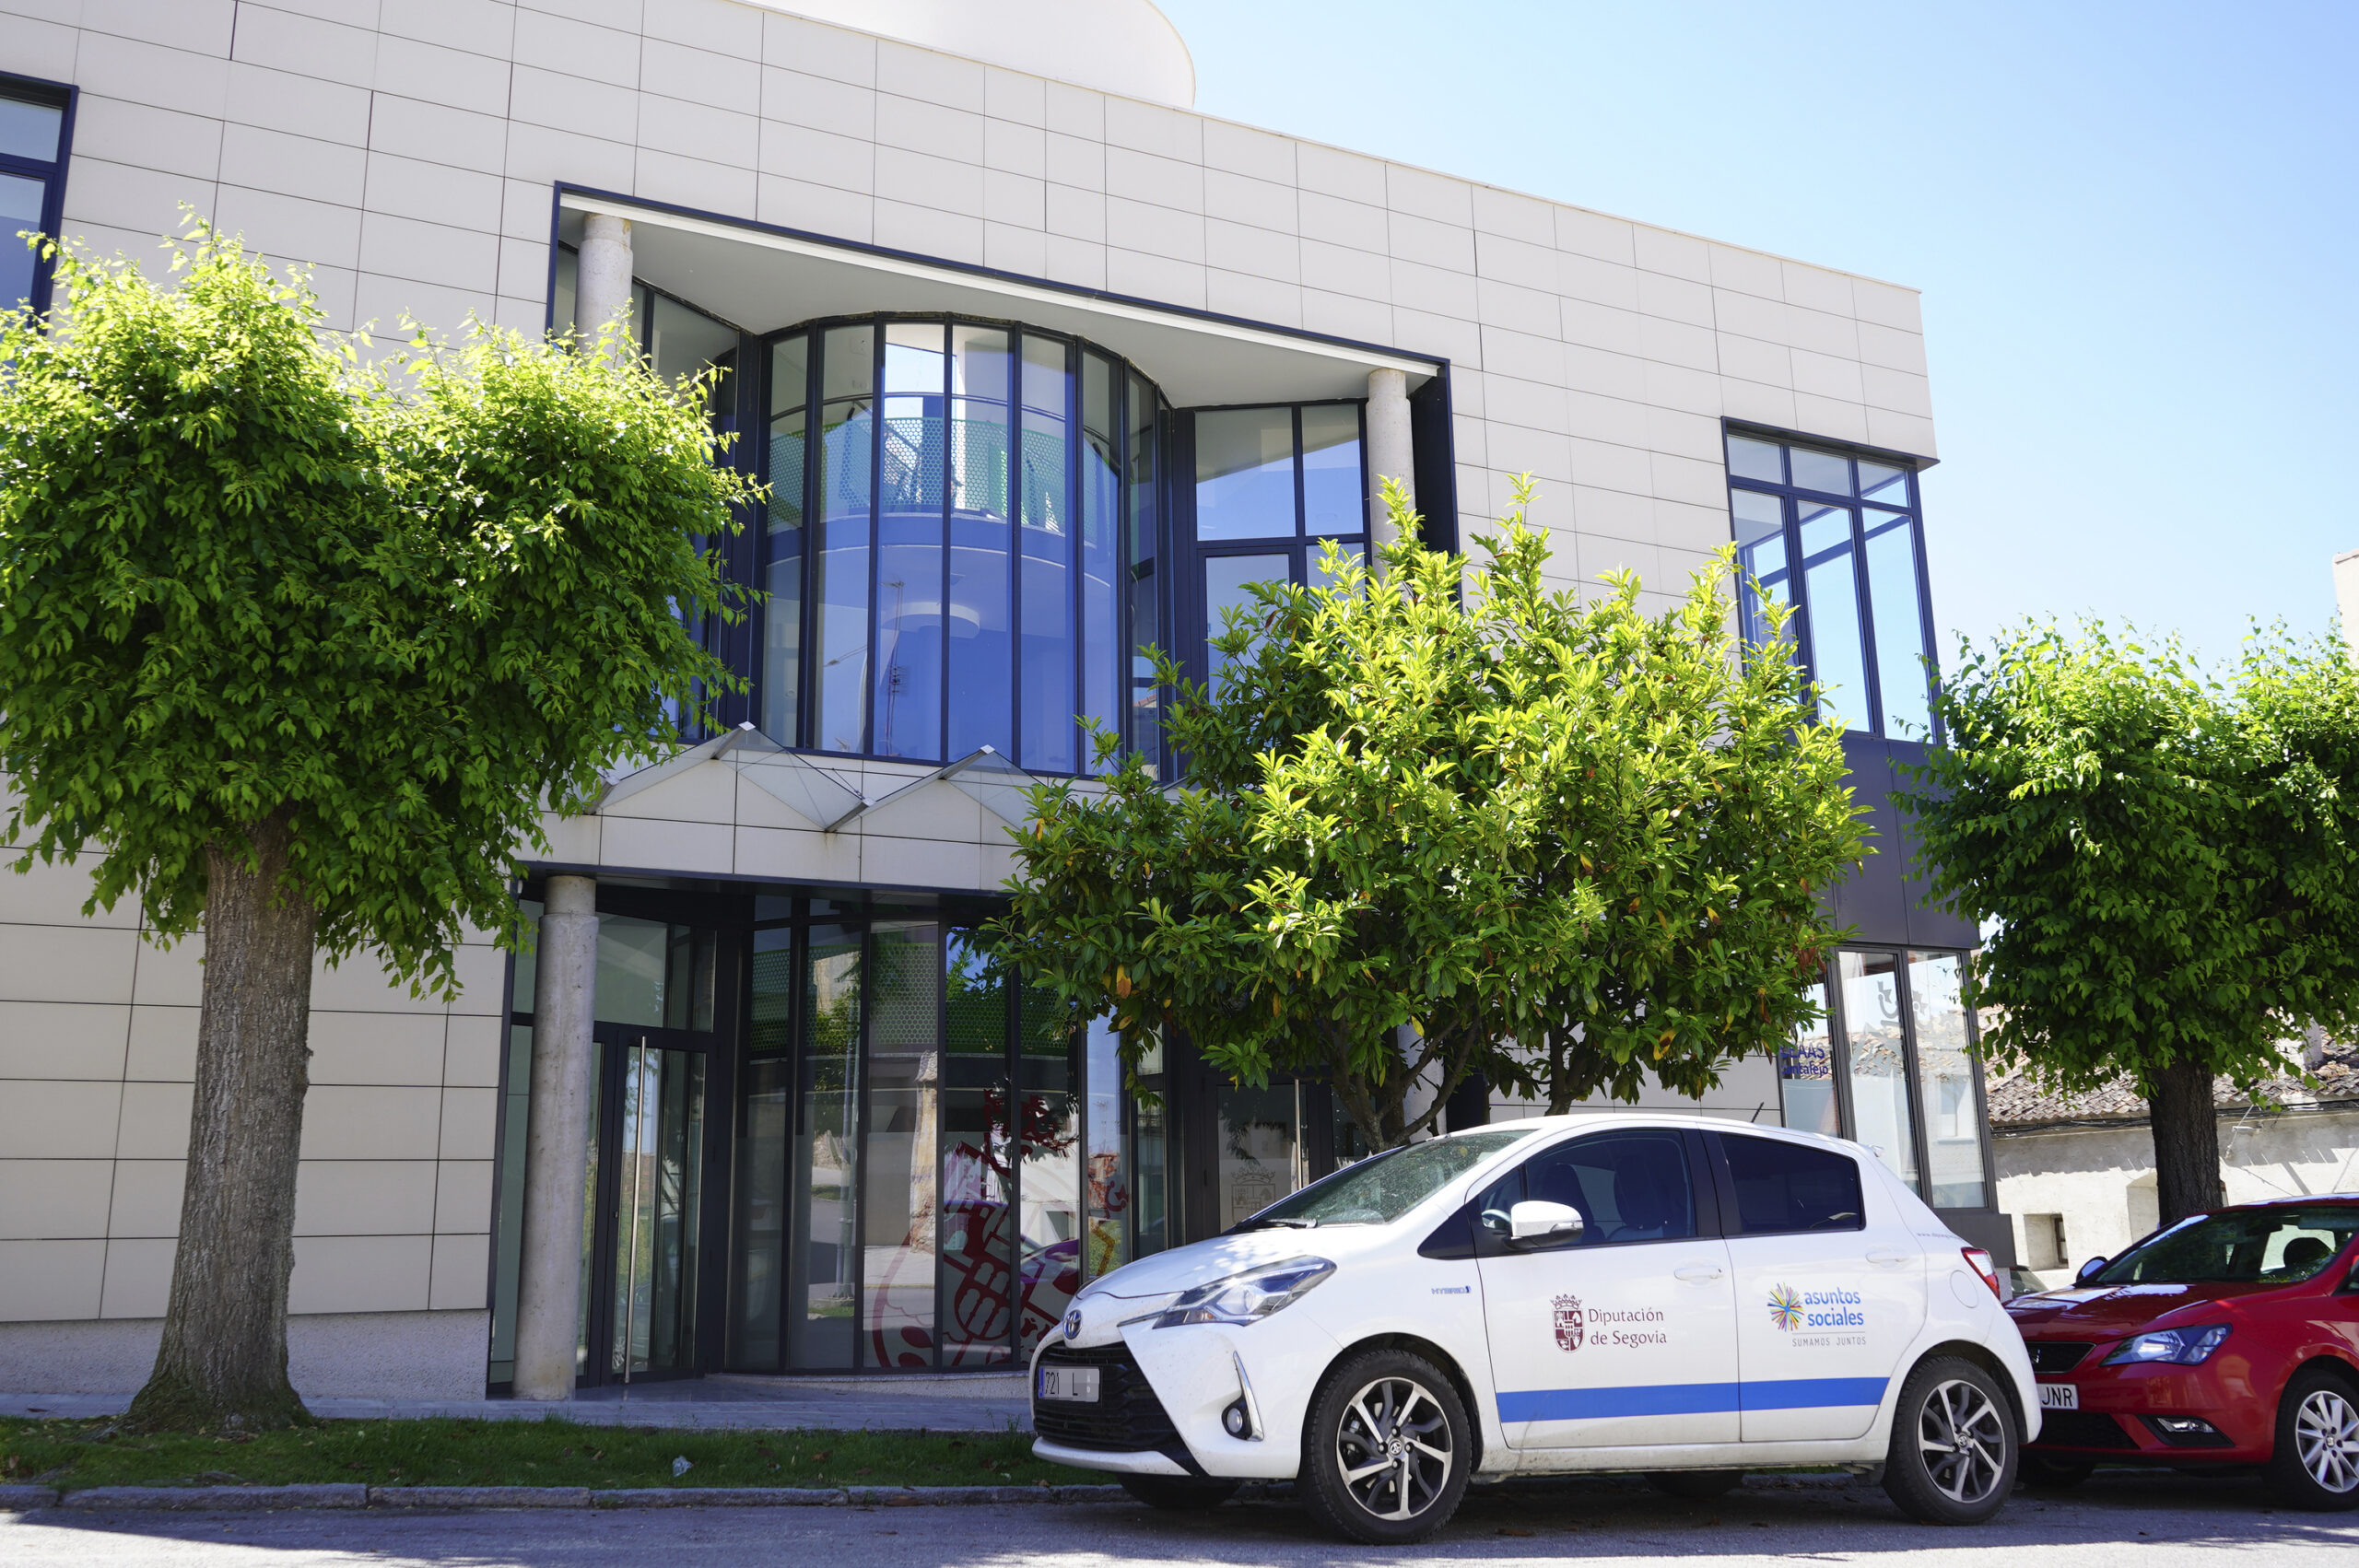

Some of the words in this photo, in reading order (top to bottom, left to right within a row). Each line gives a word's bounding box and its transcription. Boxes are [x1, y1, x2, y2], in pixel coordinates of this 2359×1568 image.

[1803, 1287, 1861, 1305] asuntos
[1588, 1307, 1664, 1326] Diputación
[1807, 1306, 1864, 1327] sociales
[1590, 1331, 1608, 1345] de
[1613, 1330, 1667, 1348] Segovia
[1791, 1338, 1830, 1347] SUMAMOS
[1837, 1337, 1866, 1346] JUNTOS
[2042, 1387, 2073, 1407] JNR
